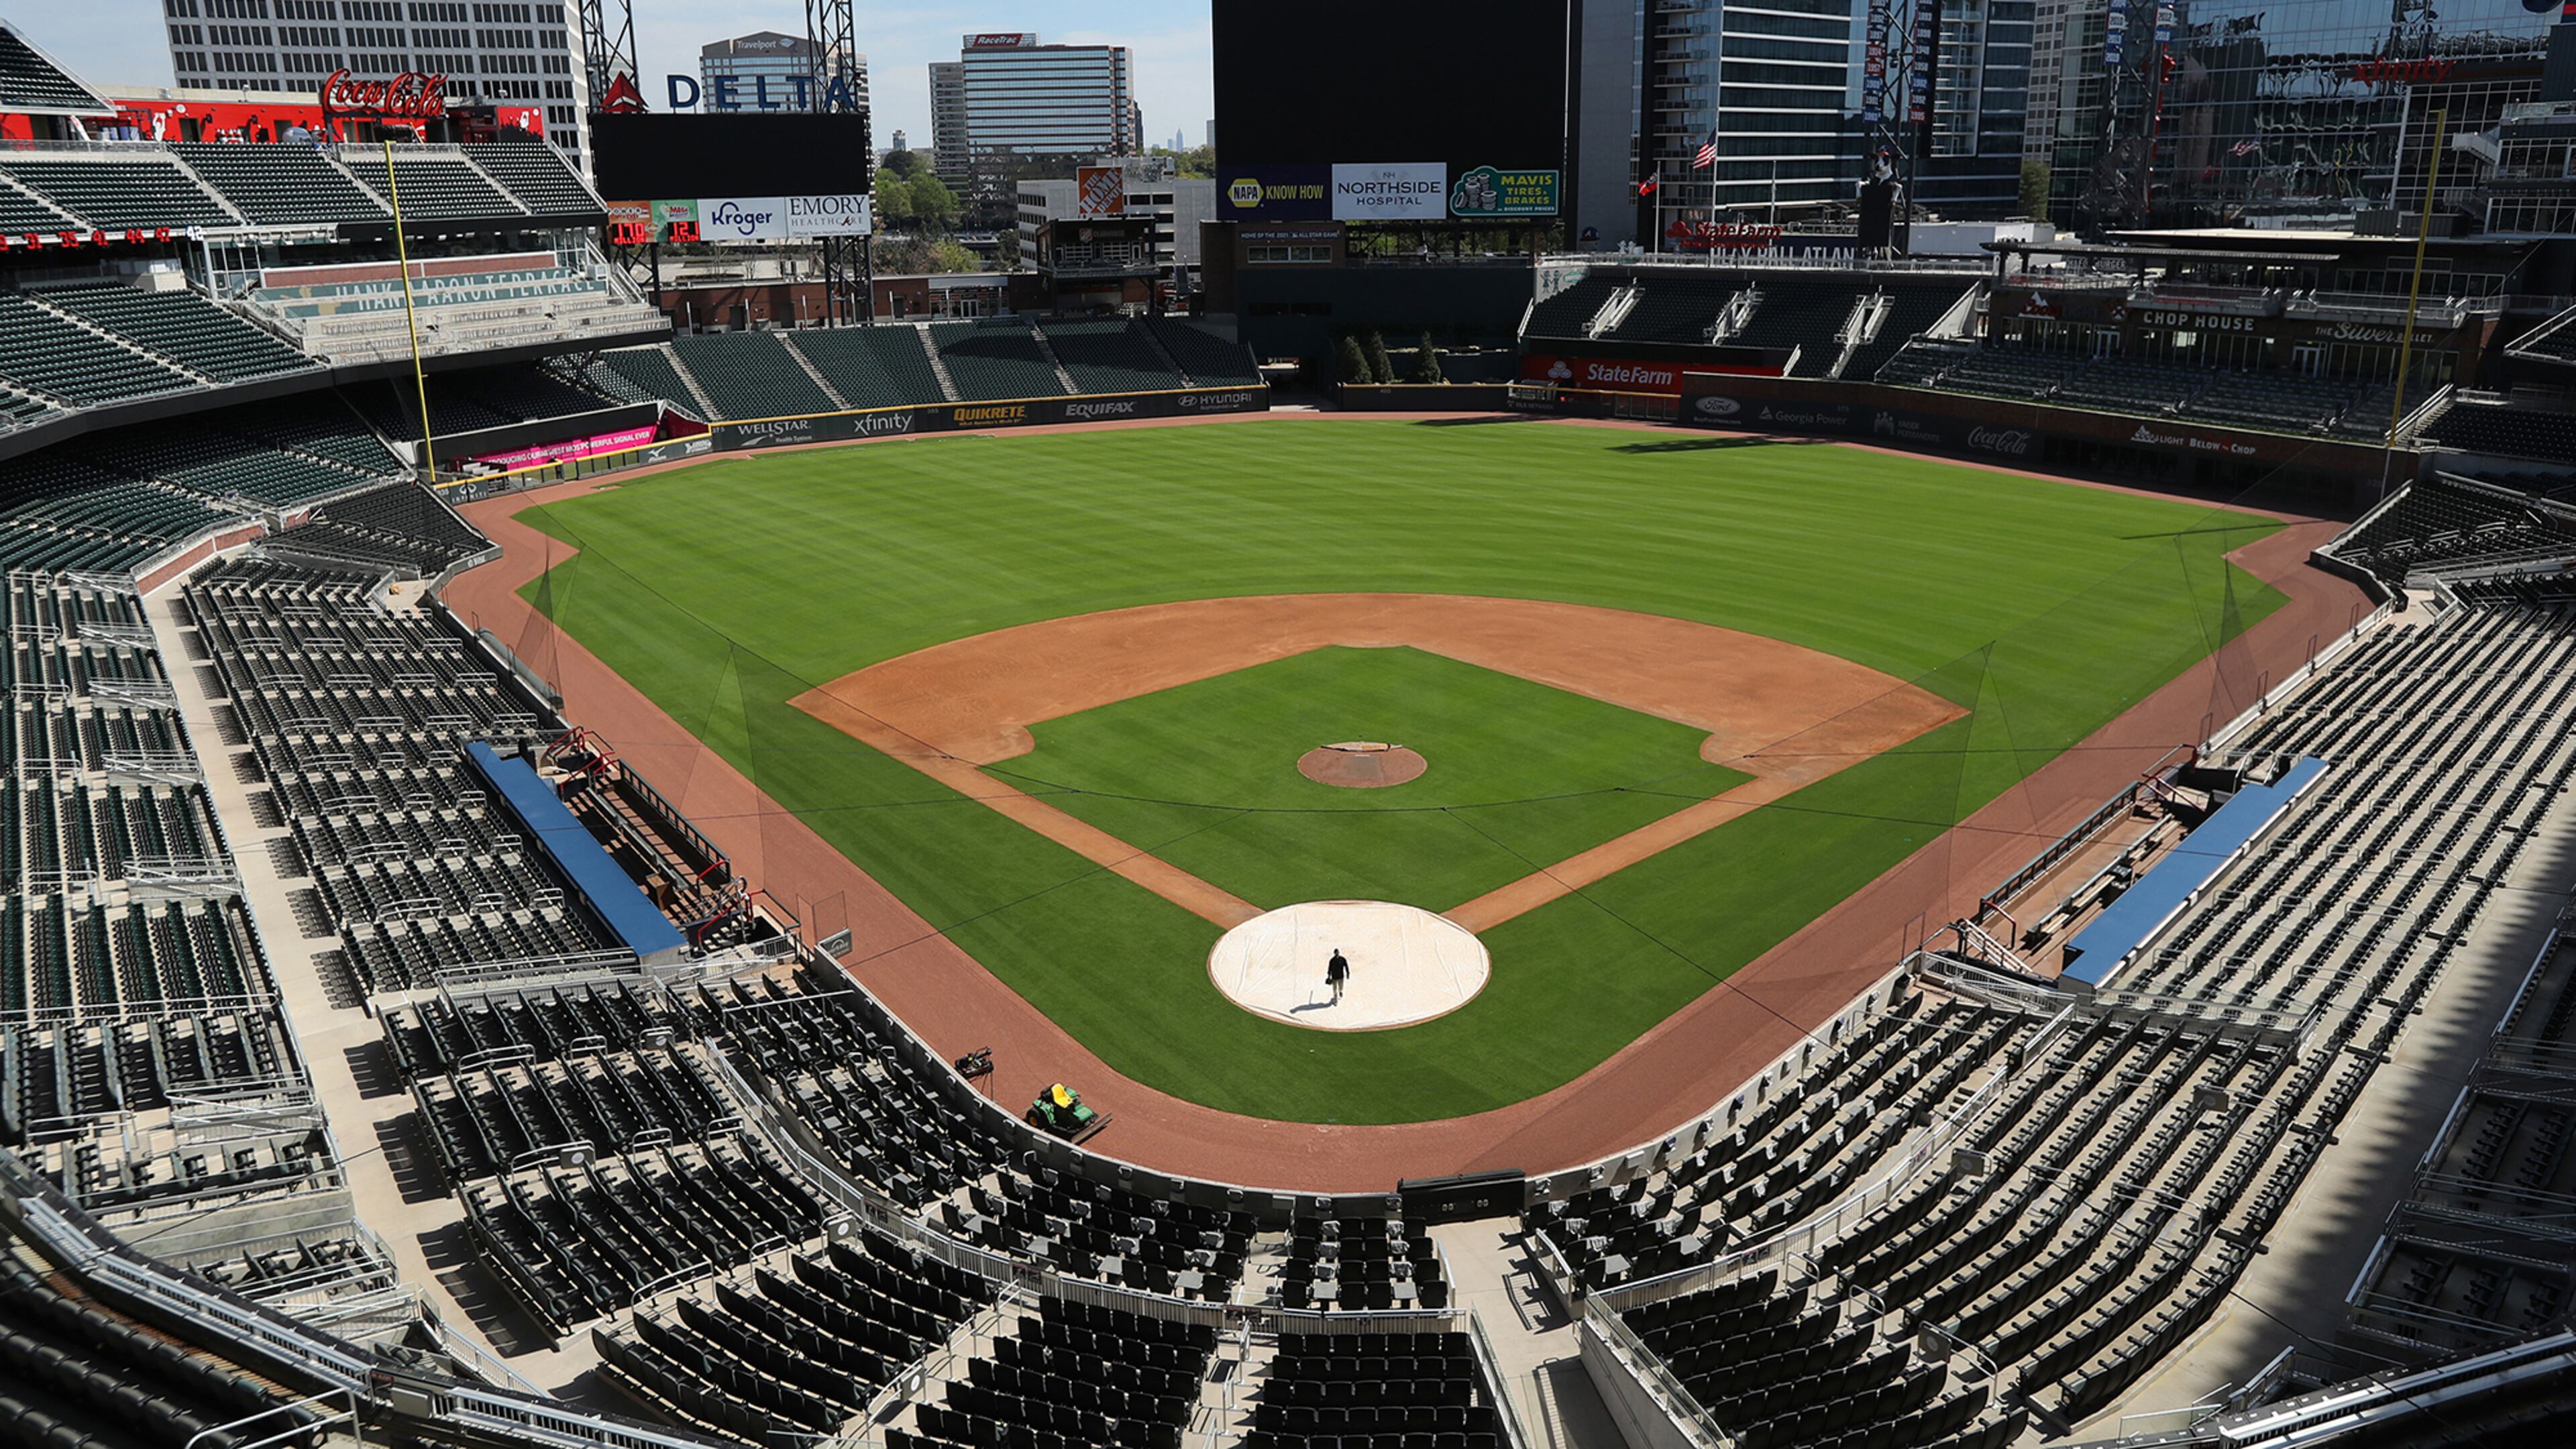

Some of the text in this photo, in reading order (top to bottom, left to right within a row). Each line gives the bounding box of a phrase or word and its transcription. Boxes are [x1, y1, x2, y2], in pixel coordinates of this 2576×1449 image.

[2158, 12, 2173, 22] 2012
[737, 40, 776, 50] Travelport
[977, 36, 1017, 44] RaceTrac
[2351, 55, 2457, 88] xfinity
[667, 75, 855, 109] DELTA
[1084, 172, 1100, 191] THE
[1501, 175, 1553, 185] MAVIS
[1079, 168, 1123, 213] HOME
[1234, 185, 1324, 200] NAPA KNOW HOW
[1338, 182, 1441, 194] NORTHSIDE
[1507, 187, 1542, 195] TIRES
[1097, 183, 1123, 213] DEPOT
[1356, 197, 1422, 205] HOSPITAL
[790, 197, 865, 215] EMORY
[712, 202, 773, 235] Kroger
[791, 216, 863, 226] HEALTHCARE
[92, 229, 109, 246] 41
[125, 228, 145, 244] 44
[154, 227, 170, 242] 47
[186, 225, 204, 241] 42
[618, 223, 645, 237] 170
[24, 233, 42, 250] 31
[58, 231, 79, 248] 35
[336, 270, 594, 311] HANK AARON TERRACE
[2143, 311, 2255, 331] CHOP HOUSE
[2315, 321, 2433, 343] THE Silver BLLET
[1199, 393, 1251, 405] HYUNDAI
[1705, 399, 1731, 411] Ford
[953, 406, 1025, 421] QUIKRETE
[1065, 402, 1134, 419] EQUIFAX
[1776, 410, 1847, 425] Georgia Power
[738, 420, 808, 435] WELLSTAR
[854, 413, 912, 435] xfinity
[1898, 421, 1920, 430] KAISER
[614, 433, 634, 445] SIGNAL
[635, 431, 650, 440] EVER
[1897, 429, 1941, 443] PERMANENTE
[1968, 425, 2033, 455] Coca-Cola
[2159, 435, 2185, 445] LIGHT
